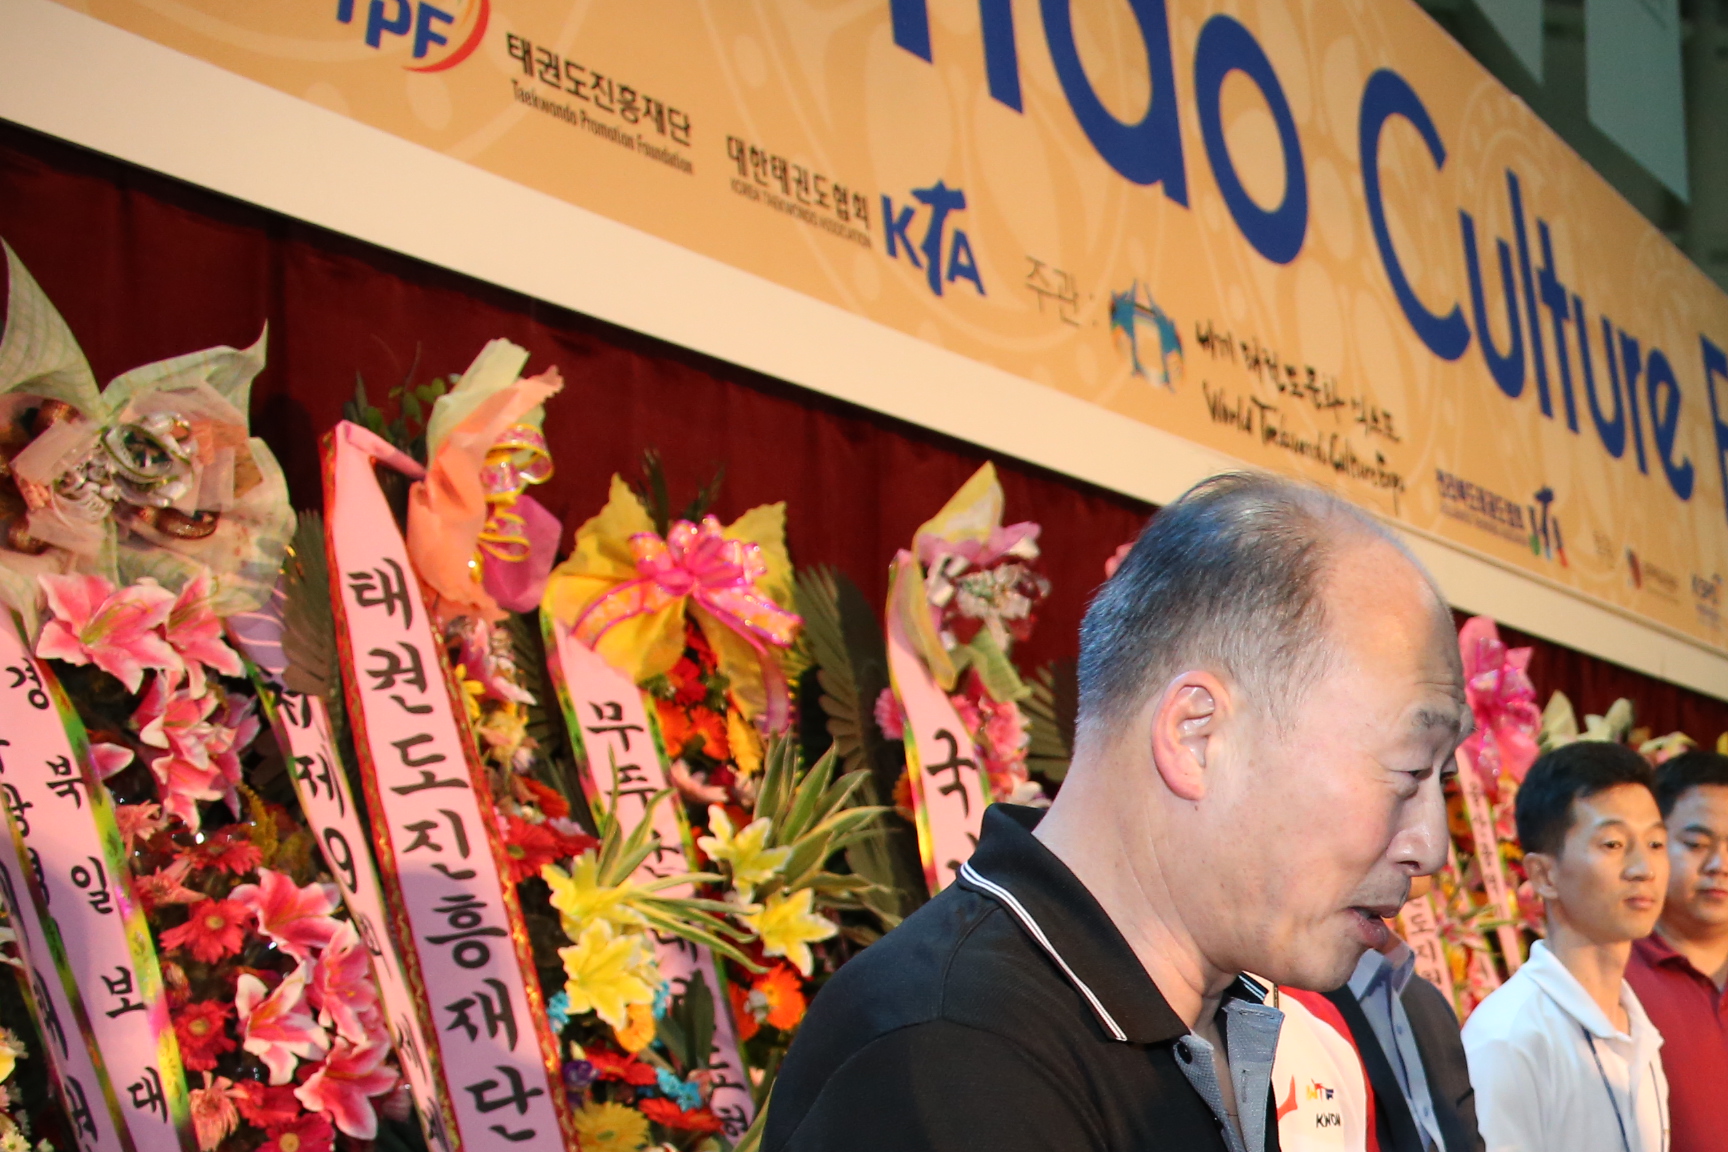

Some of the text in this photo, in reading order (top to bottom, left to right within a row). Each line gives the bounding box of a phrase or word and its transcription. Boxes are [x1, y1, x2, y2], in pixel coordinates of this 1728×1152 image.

[506, 31, 692, 147] 태권도진흥재단
[511, 78, 694, 175] Taekwondo Promotion Foundation
[726, 134, 871, 230] 대한태권도협회
[880, 180, 986, 297] KTA
[1359, 67, 1695, 501] Culture
[347, 557, 544, 1143] 태권도진흥재단
